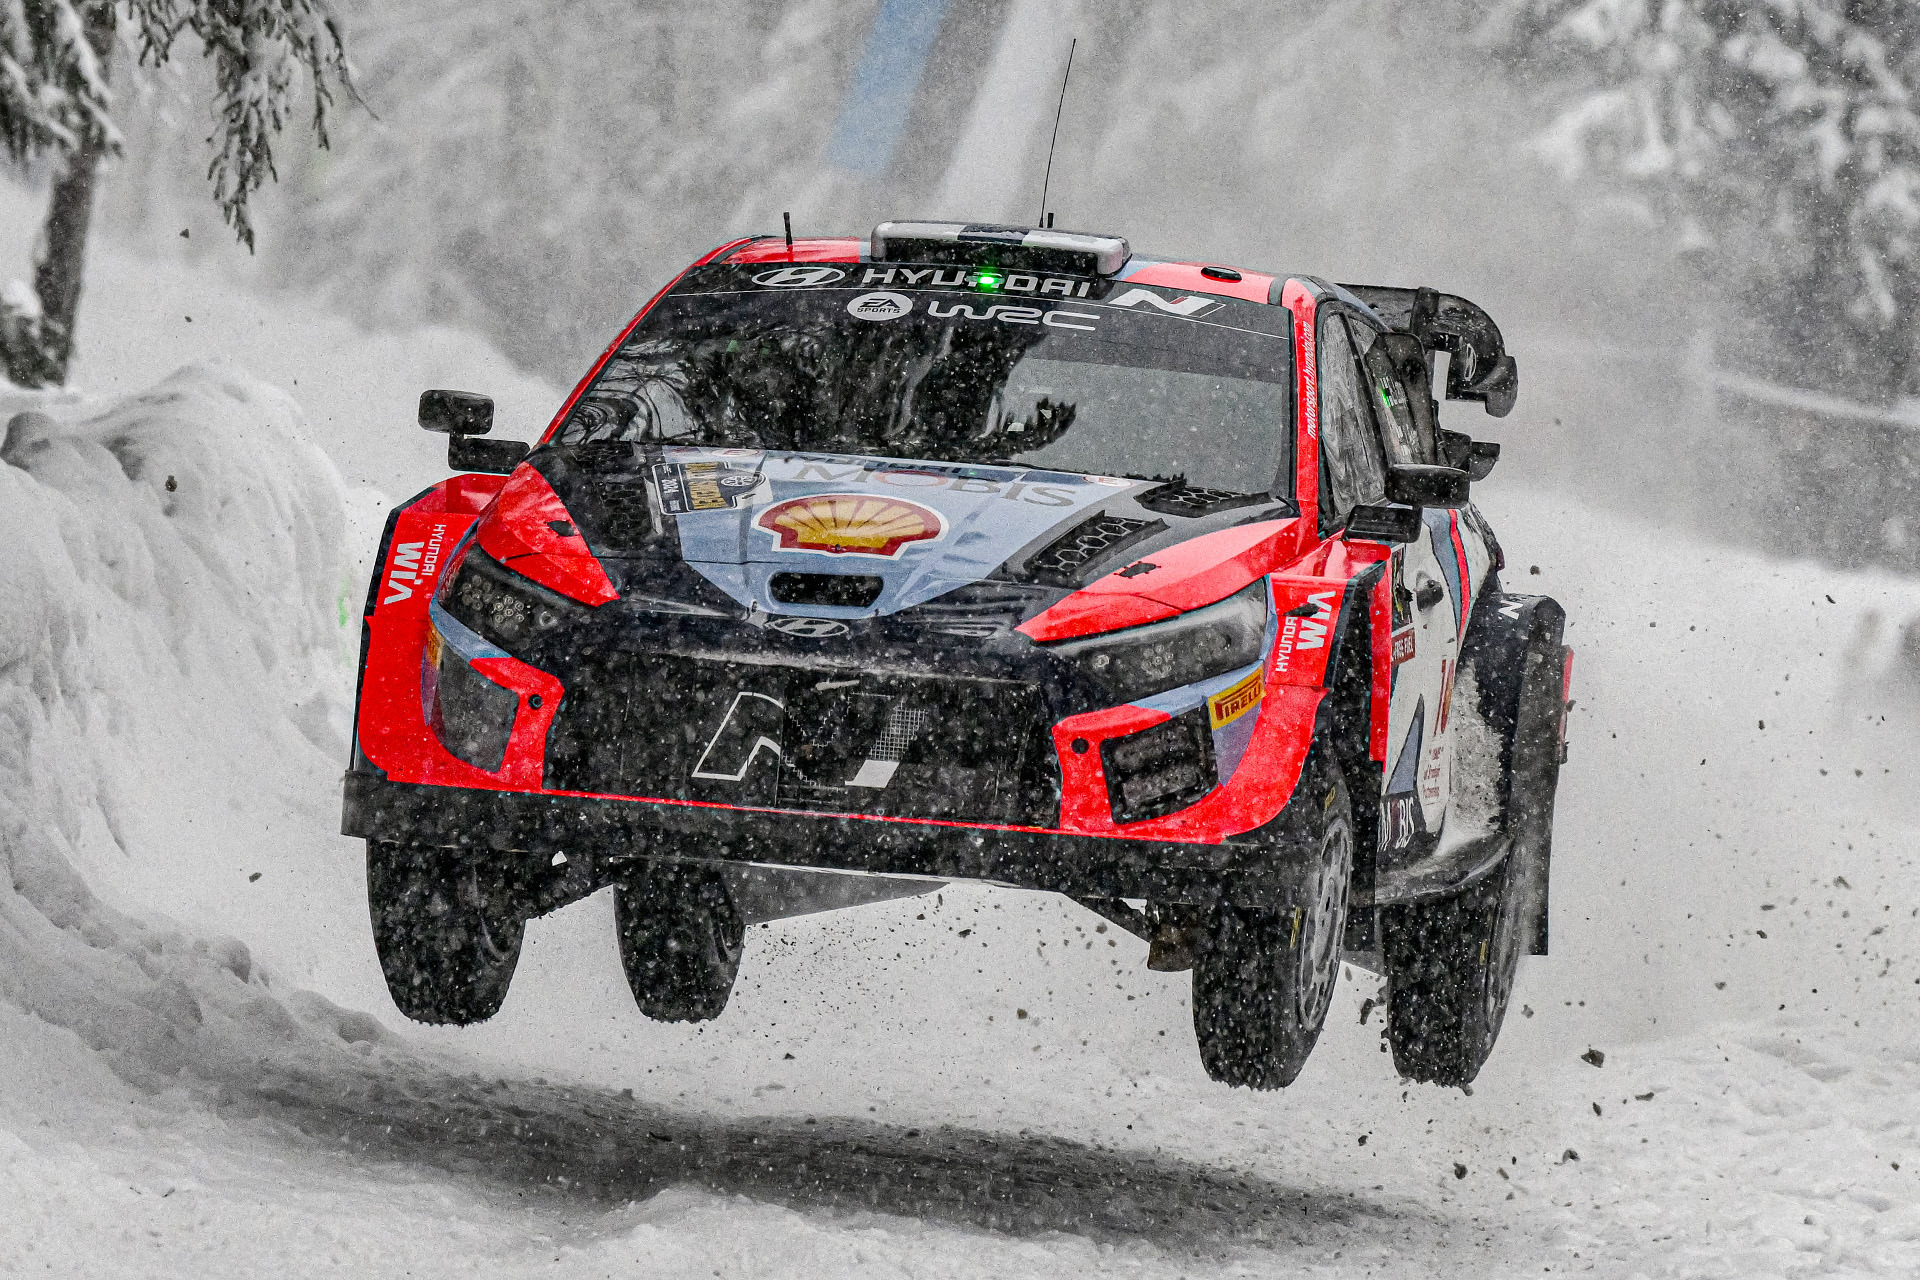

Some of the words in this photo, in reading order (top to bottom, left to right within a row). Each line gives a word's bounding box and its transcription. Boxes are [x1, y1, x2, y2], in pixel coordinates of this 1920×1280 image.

[860, 297, 900, 308] EA
[862, 267, 1091, 298] HYUDAI
[856, 306, 901, 314] SPORTS
[927, 300, 1101, 331] WRC
[1301, 320, 1318, 440] motorsport.hyundai.com
[792, 463, 1077, 507] MOBIS
[421, 523, 447, 577] HYUNDAI
[1275, 615, 1299, 673] HYUNDA
[1213, 674, 1263, 722] PIRELLI
